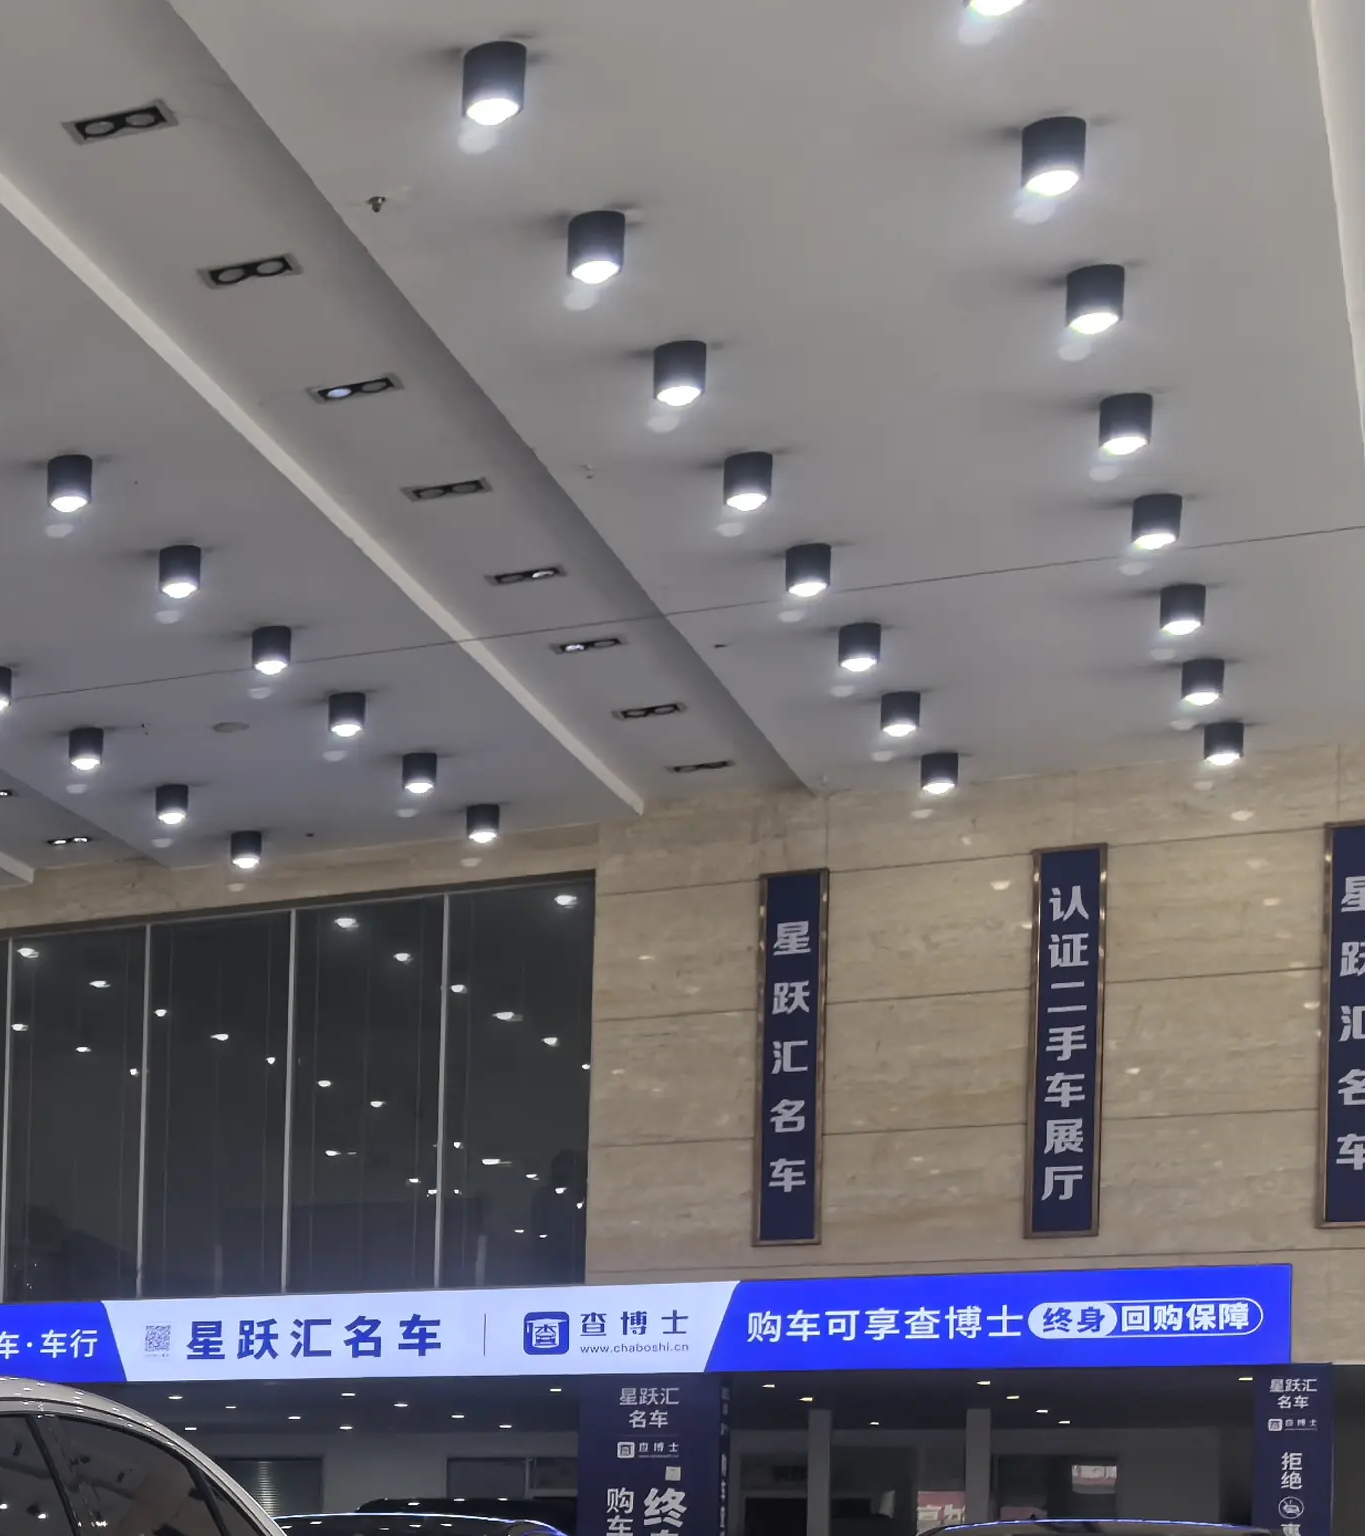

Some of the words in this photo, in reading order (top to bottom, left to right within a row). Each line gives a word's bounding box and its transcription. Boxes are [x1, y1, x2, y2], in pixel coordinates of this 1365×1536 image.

[1040, 885, 1090, 1202] 认证二手车展厅
[768, 920, 812, 1193] 星跃汇名车
[579, 1310, 689, 1338] 查博士
[186, 1313, 442, 1360] 星跃汇名车
[579, 1341, 689, 1355] www.chaboshi.cn
[1269, 1378, 1318, 1393] 星跃汇
[619, 1387, 680, 1405] 星跃汇
[1277, 1395, 1309, 1409] 名车
[629, 1410, 669, 1428] 名车
